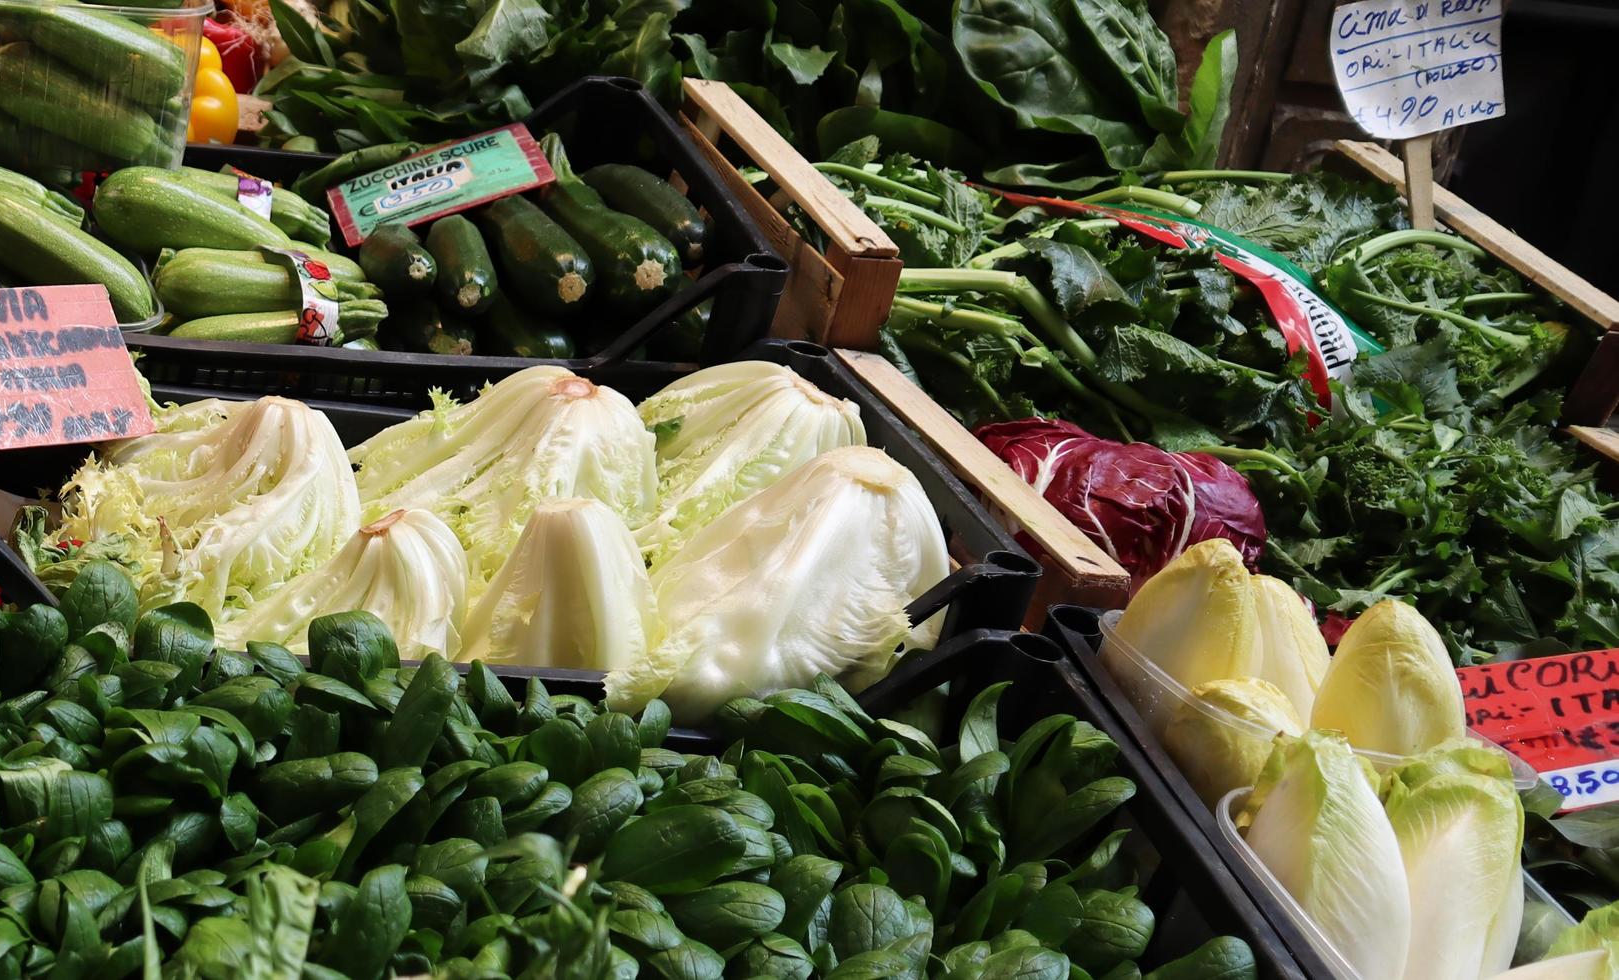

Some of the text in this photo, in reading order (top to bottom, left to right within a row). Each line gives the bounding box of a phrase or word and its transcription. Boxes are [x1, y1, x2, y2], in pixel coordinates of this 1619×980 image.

[346, 136, 500, 194] ZUCCHINE SCURE
[390, 160, 464, 190] ITALIA
